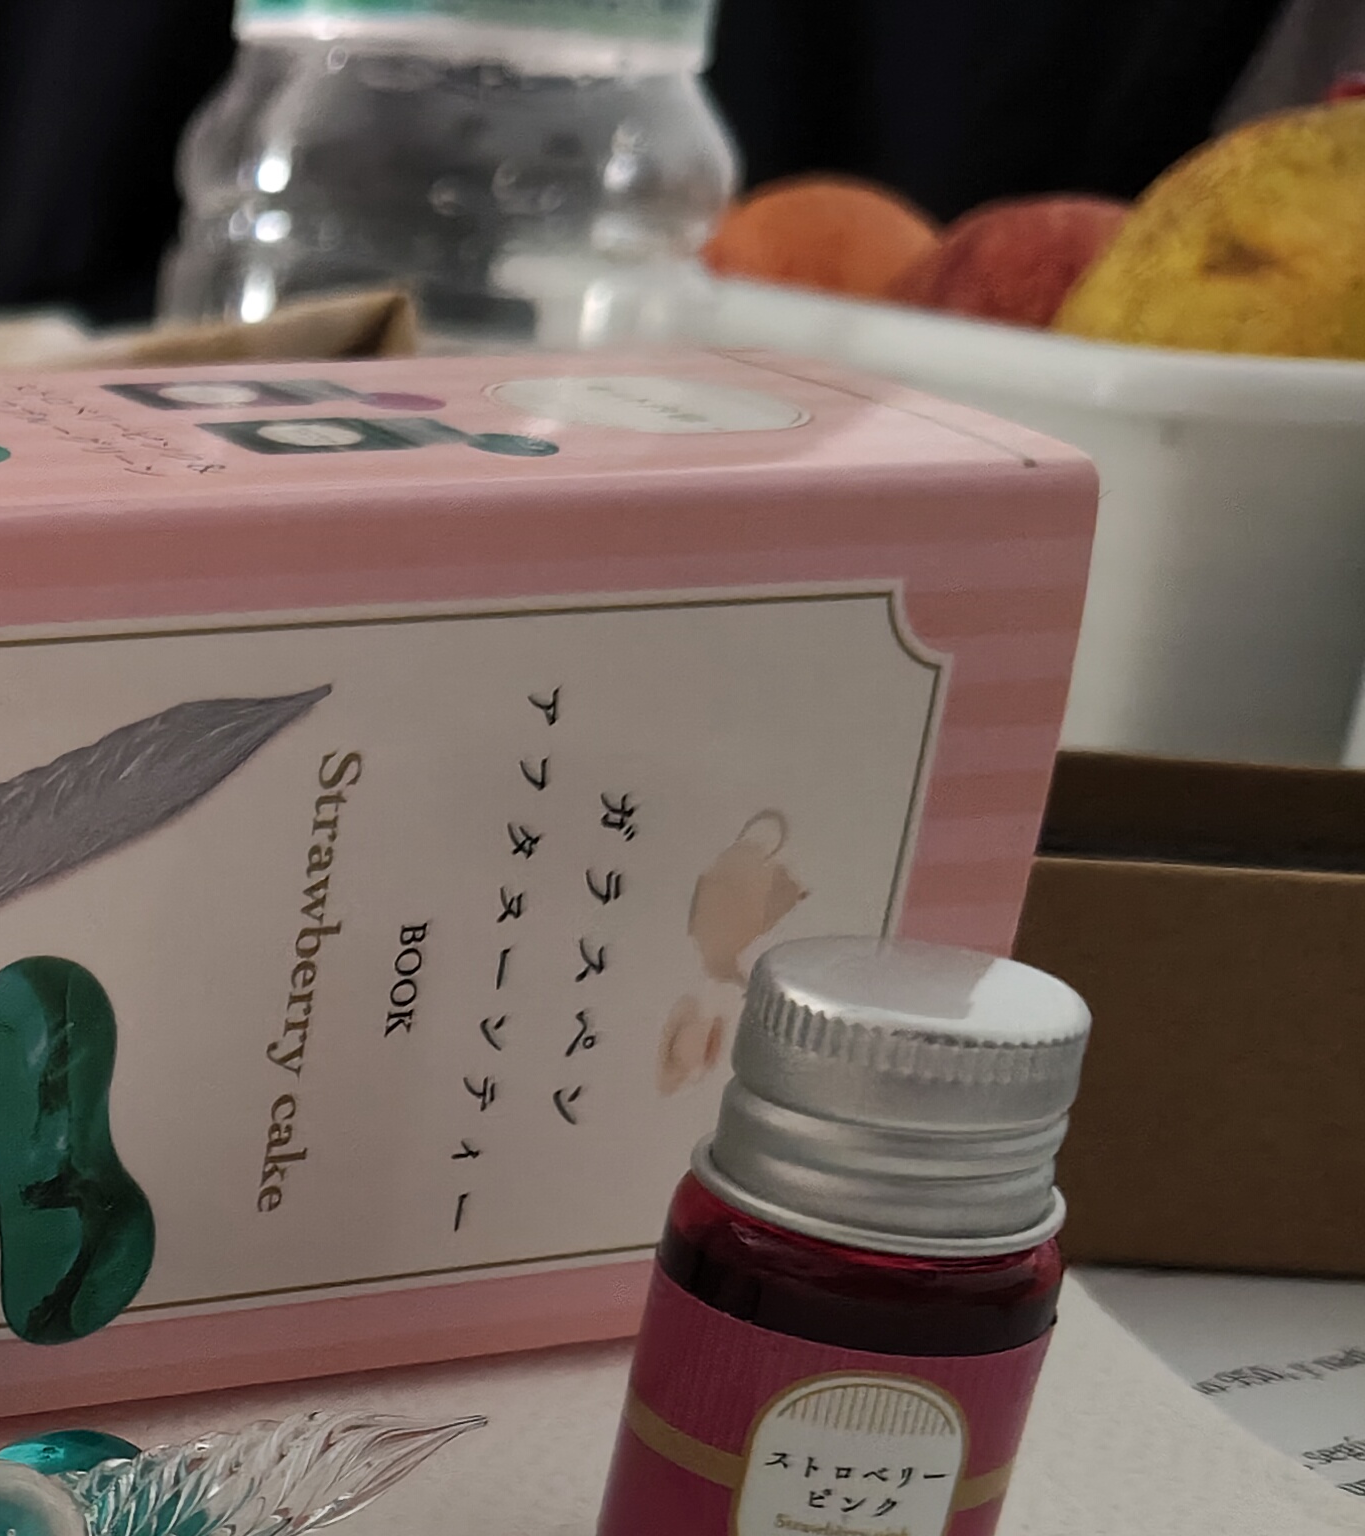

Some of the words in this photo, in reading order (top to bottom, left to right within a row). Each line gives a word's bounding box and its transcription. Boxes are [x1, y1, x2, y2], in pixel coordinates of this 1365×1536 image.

[266, 749, 363, 1077] Strawberry
[450, 686, 562, 1232] アフタヌーンティー
[552, 791, 638, 1125] ガラスペン
[384, 919, 430, 1038] BOOK
[256, 1092, 309, 1213] cake
[763, 1451, 950, 1489] ストロベリー
[807, 1488, 899, 1518] ピンク
